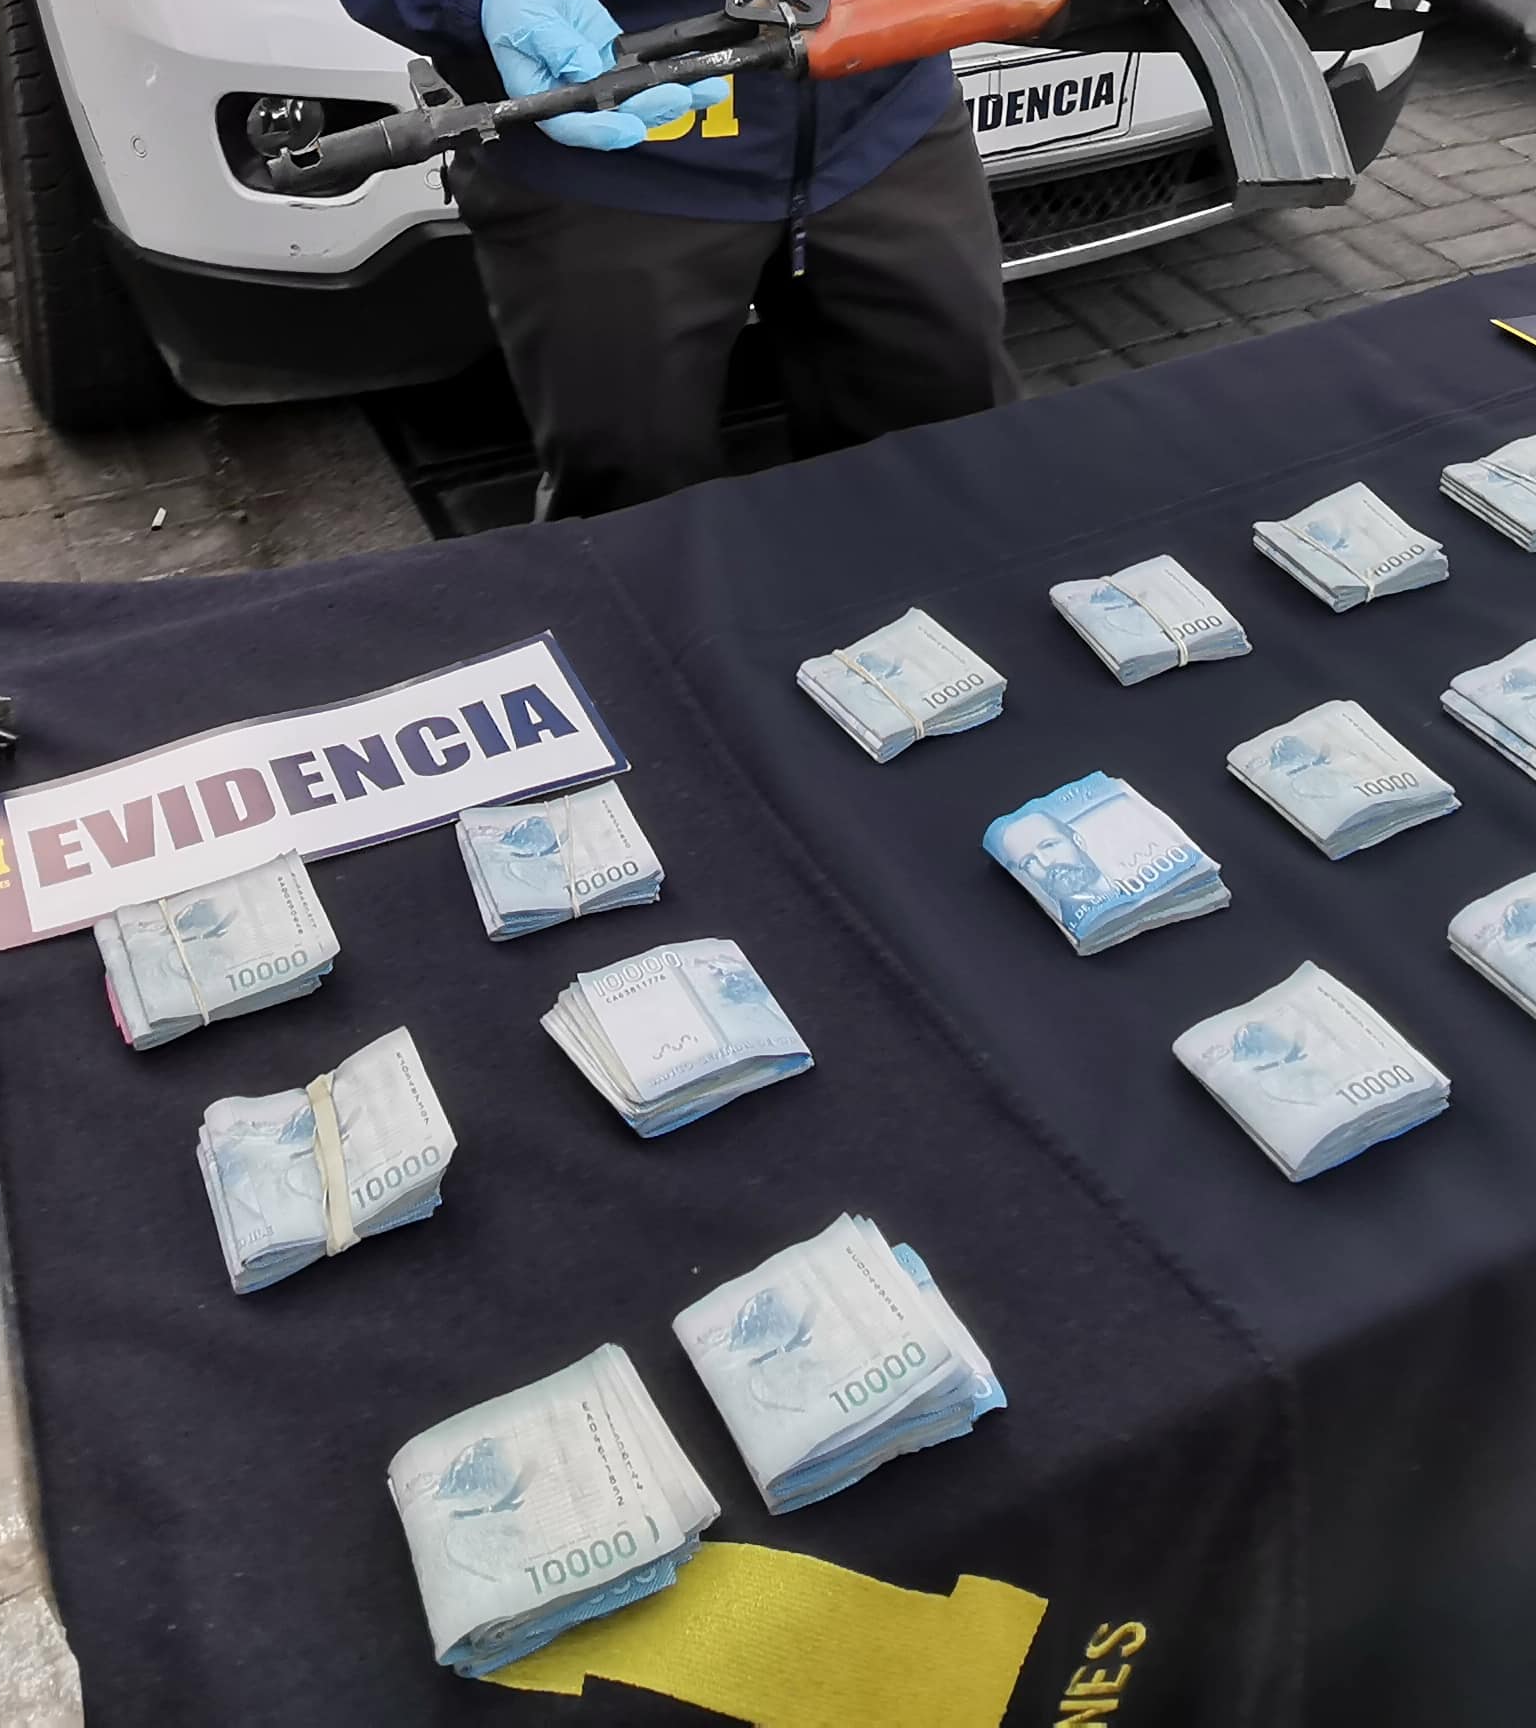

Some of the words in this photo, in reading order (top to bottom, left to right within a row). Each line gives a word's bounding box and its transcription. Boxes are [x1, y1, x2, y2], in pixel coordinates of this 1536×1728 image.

[922, 673, 984, 711] 10000
[28, 683, 578, 888] EVIDENCIA
[1354, 772, 1419, 799] 10000
[225, 949, 309, 992] 10000
[593, 951, 683, 997] 10000
[1336, 1064, 1415, 1108] 10000
[351, 1144, 441, 1208] 10000
[829, 1342, 926, 1413] 10000
[525, 1529, 638, 1595] 10000
